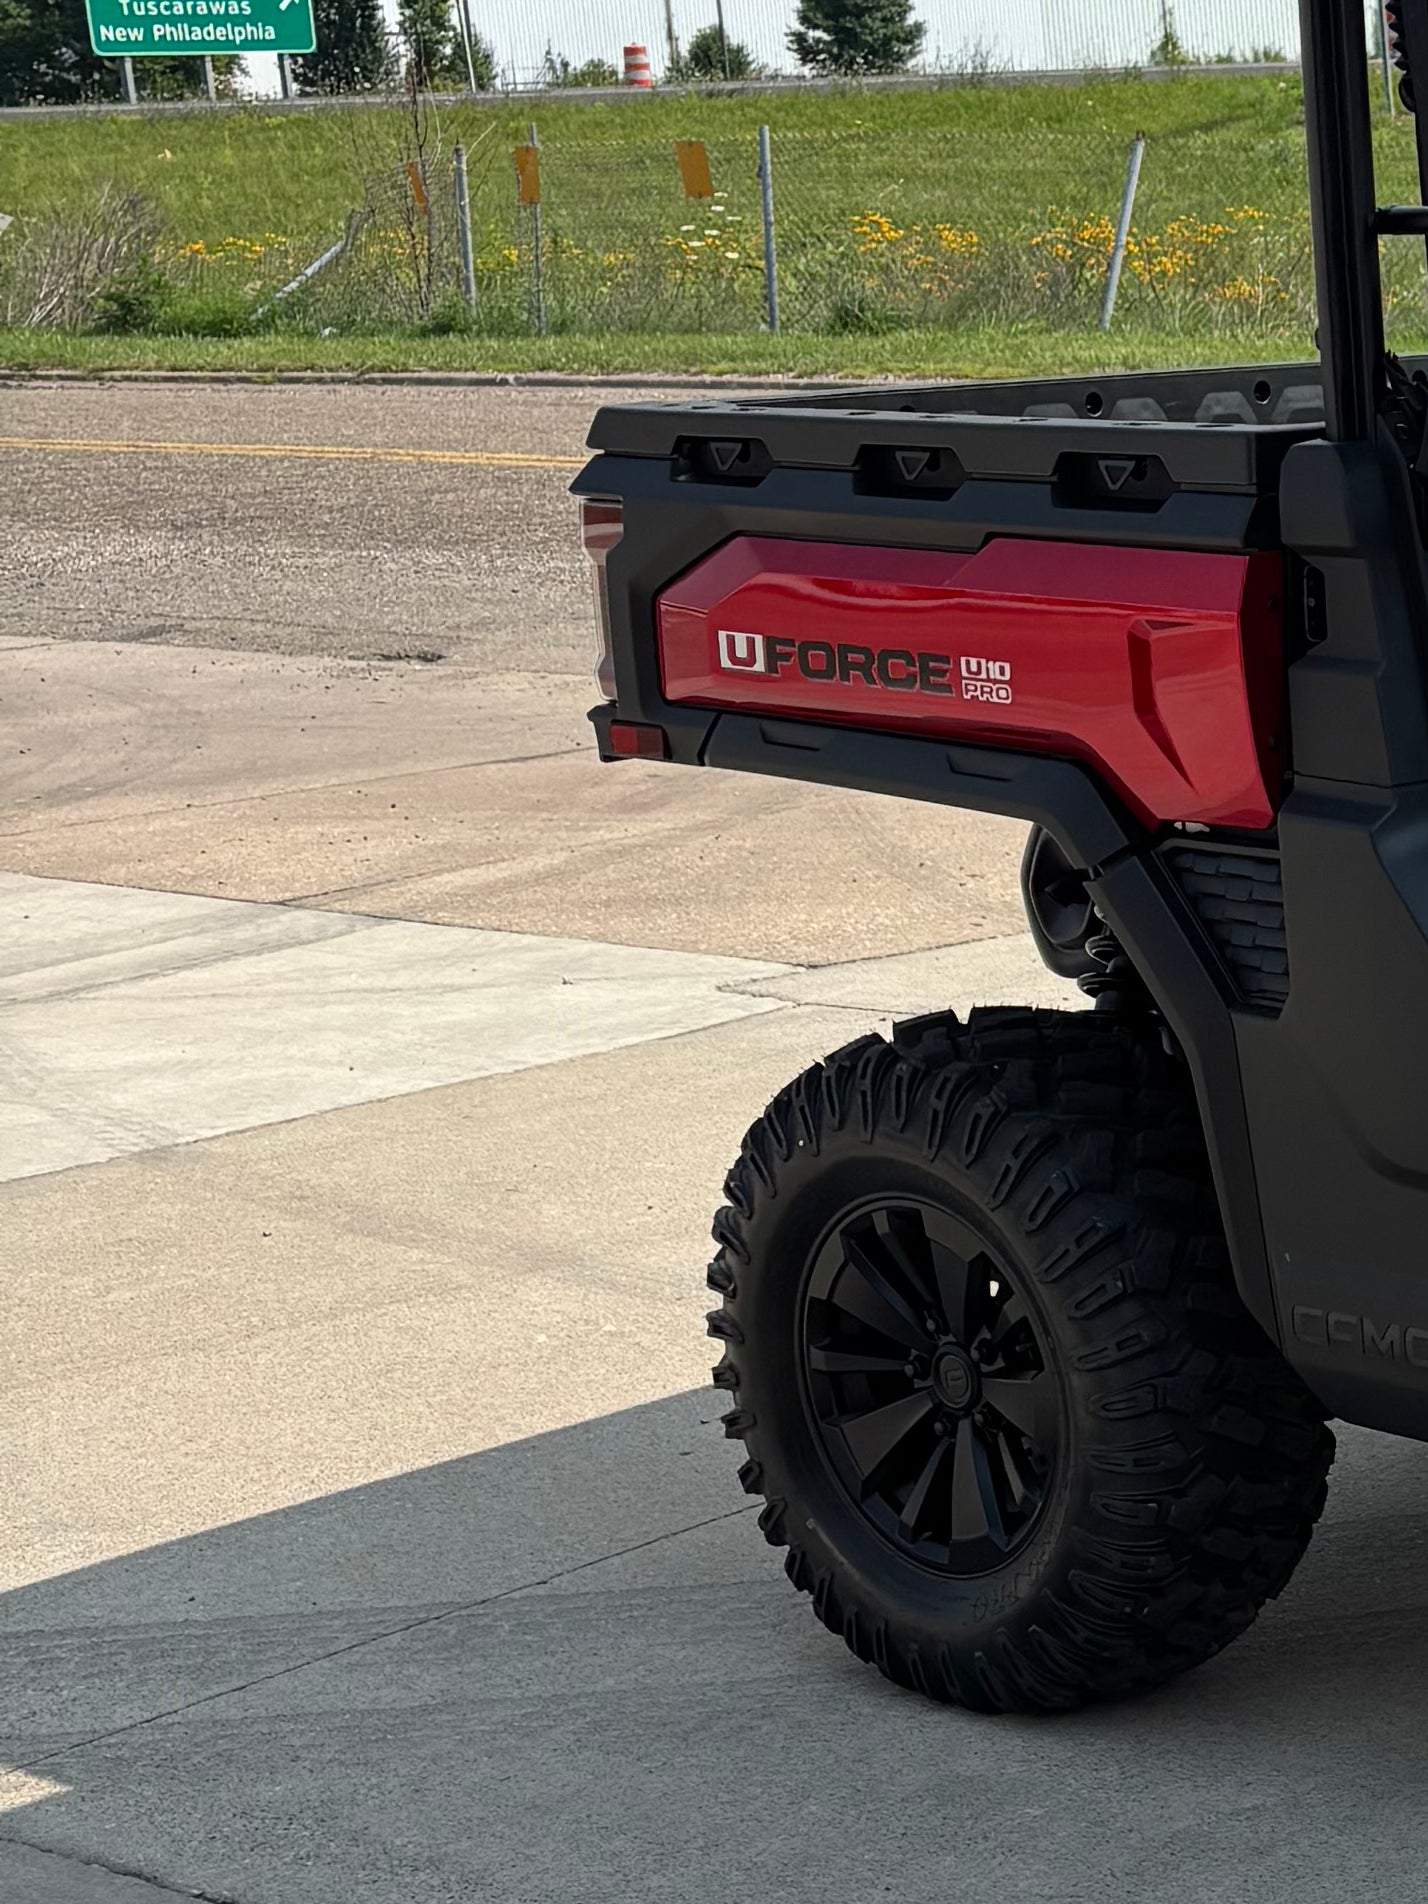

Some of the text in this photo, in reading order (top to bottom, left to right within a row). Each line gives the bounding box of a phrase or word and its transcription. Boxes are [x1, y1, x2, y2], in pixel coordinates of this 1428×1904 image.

[100, 22, 276, 45] New Philadelphia
[960, 656, 1011, 681] U10
[962, 680, 1012, 704] PRO
